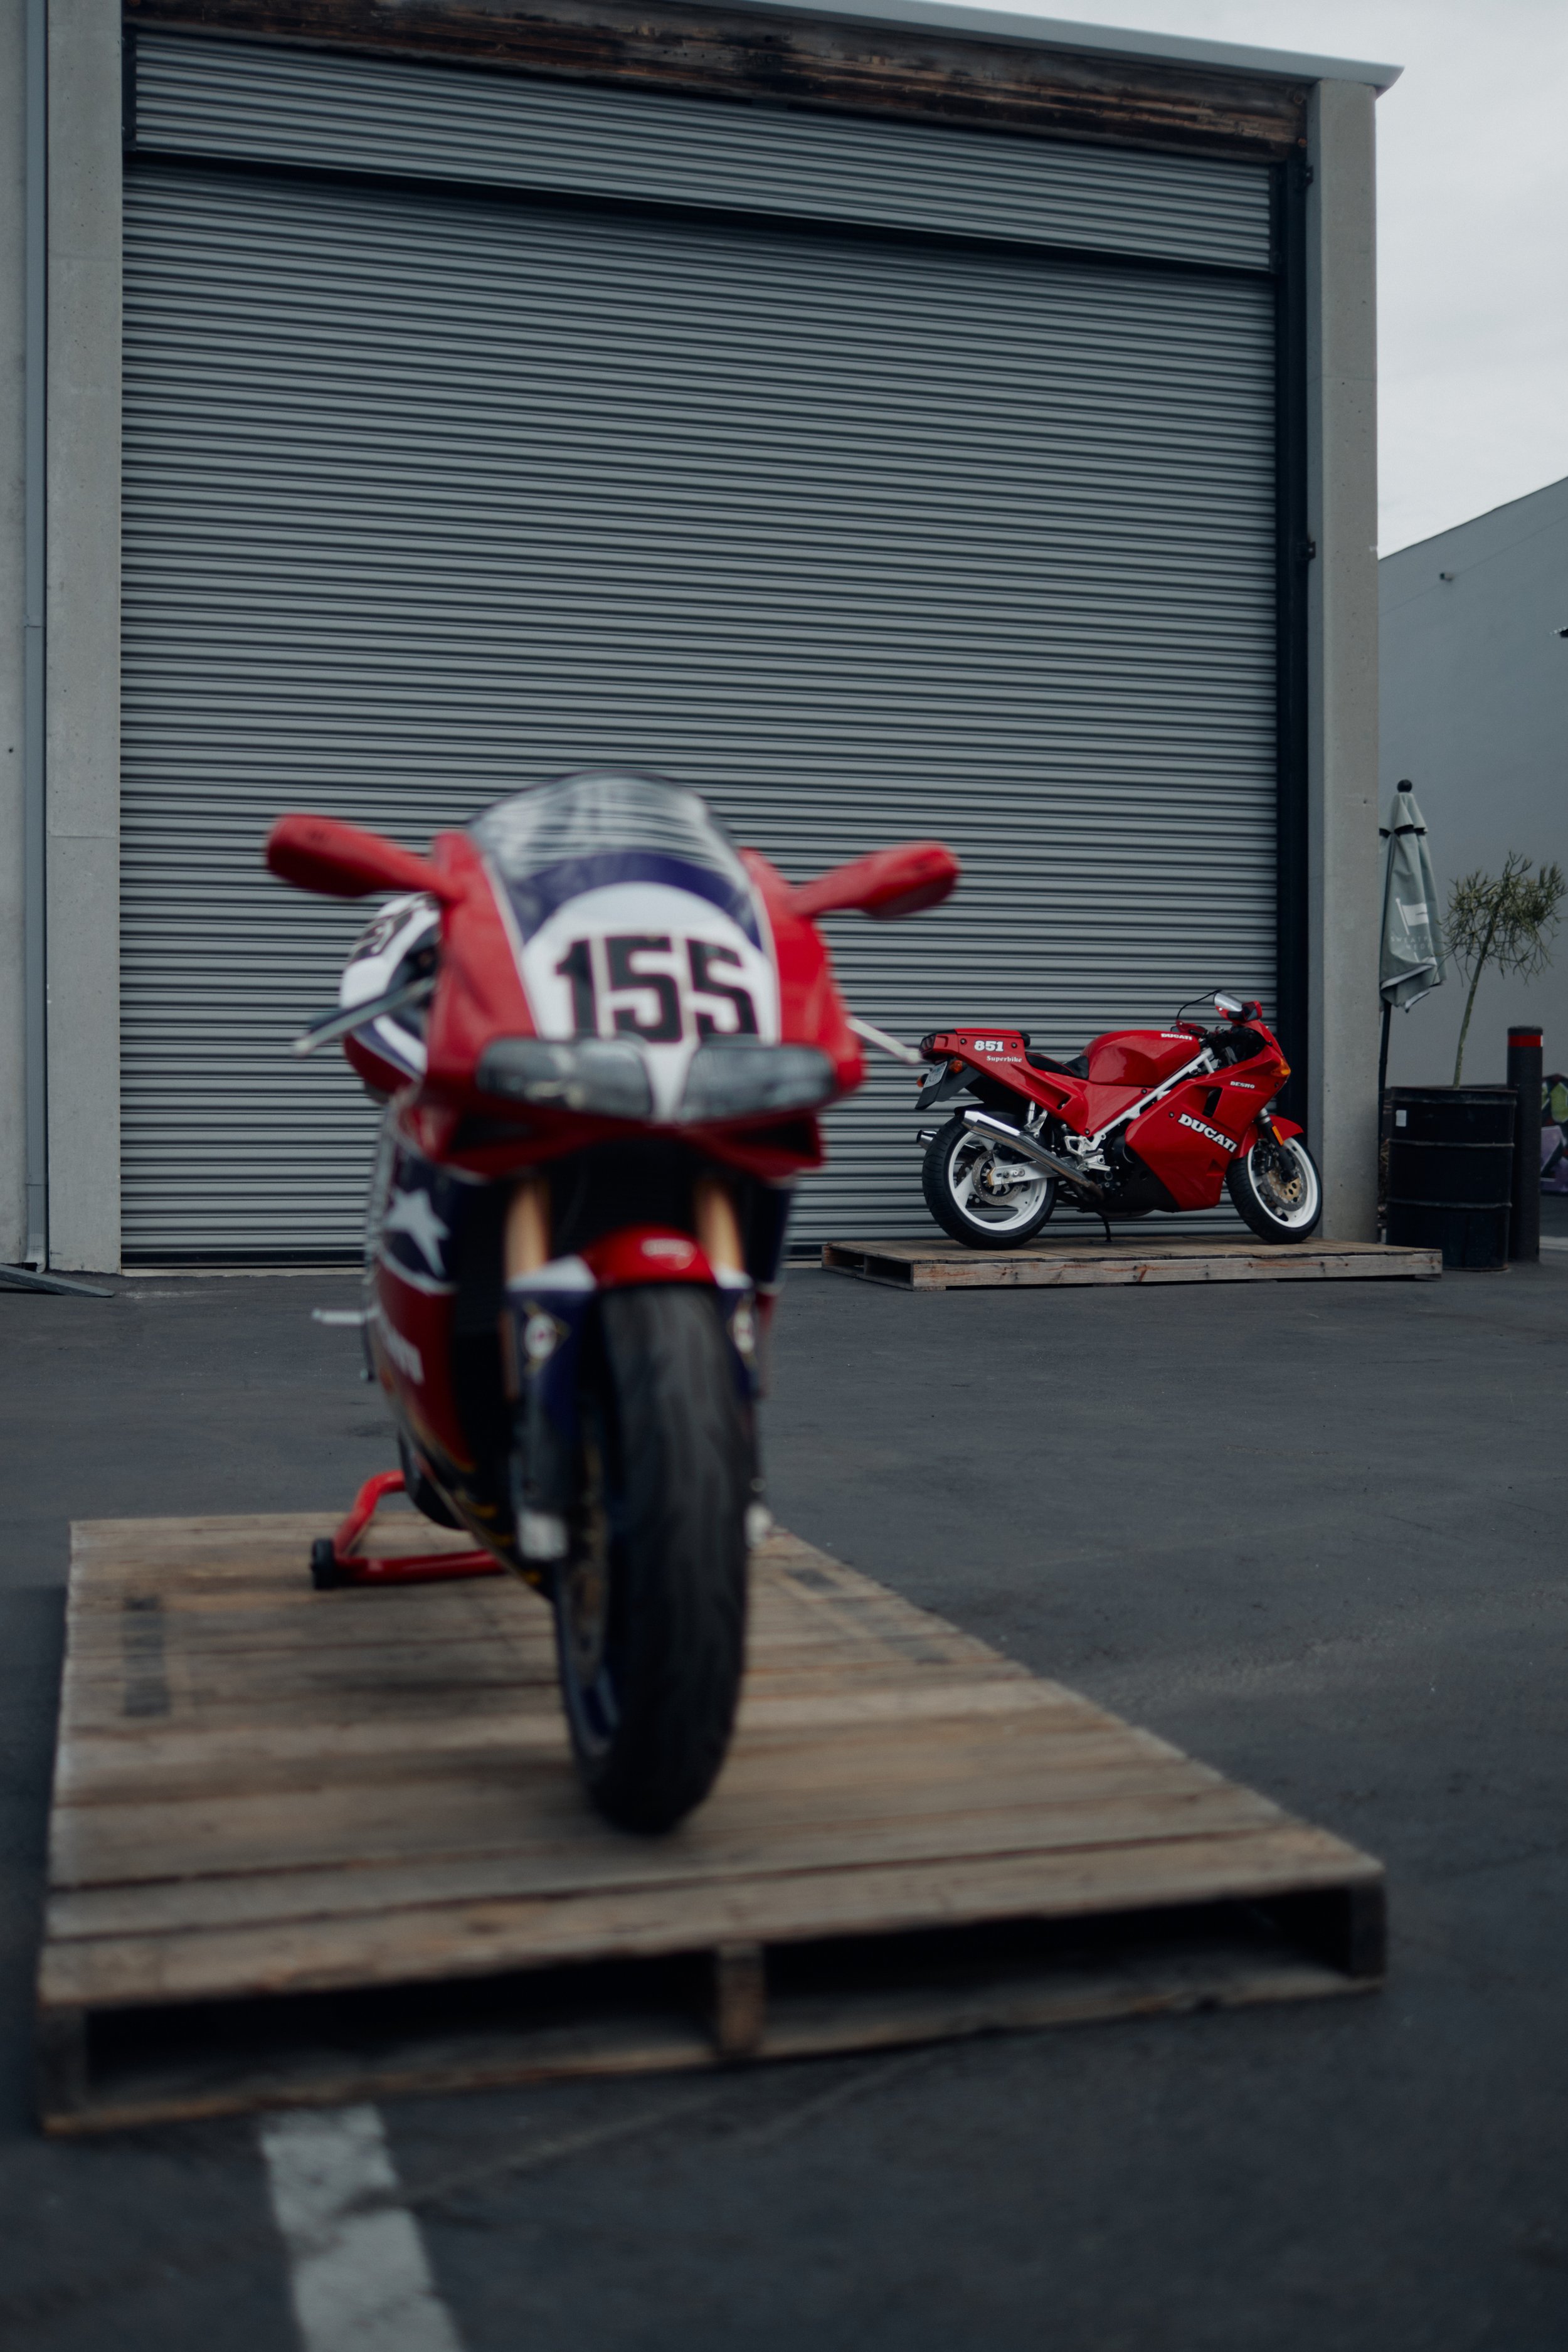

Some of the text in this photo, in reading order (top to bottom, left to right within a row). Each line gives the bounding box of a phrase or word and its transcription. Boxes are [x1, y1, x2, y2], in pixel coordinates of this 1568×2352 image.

[556, 935, 760, 1044] 155
[974, 1040, 1004, 1052] 851
[1230, 1081, 1255, 1089] DESMO
[1178, 1113, 1238, 1153] DUCATI
